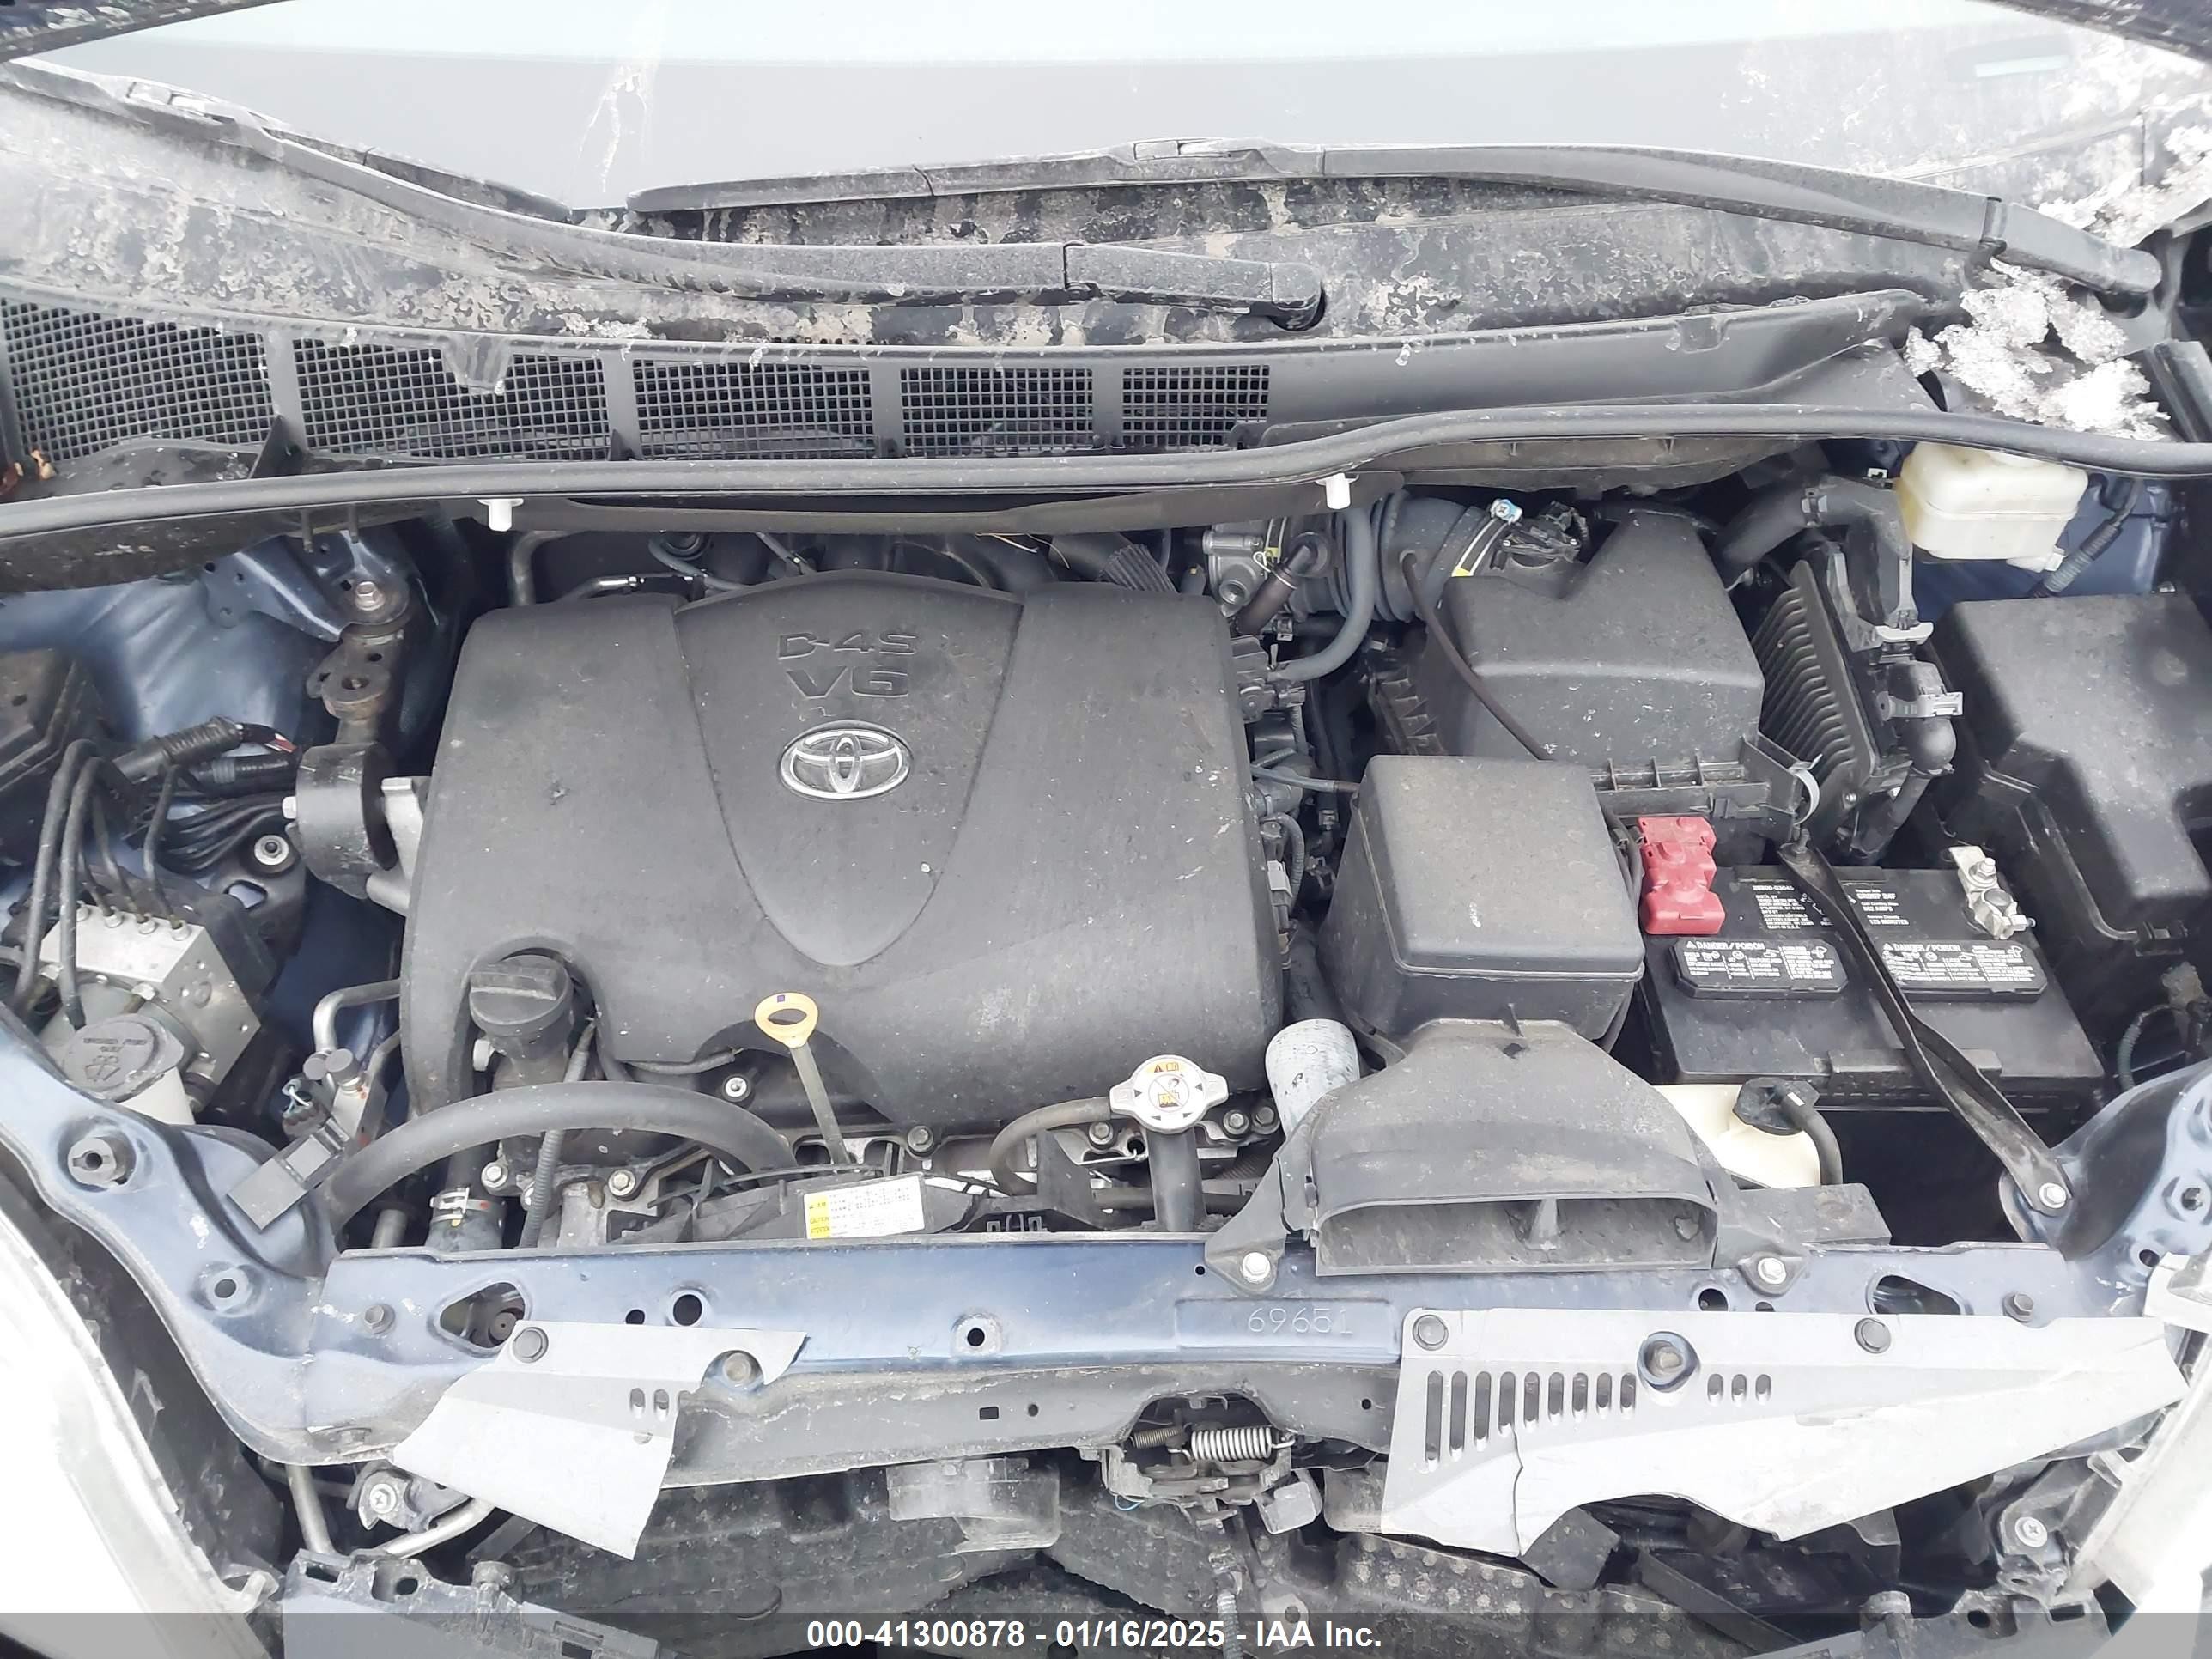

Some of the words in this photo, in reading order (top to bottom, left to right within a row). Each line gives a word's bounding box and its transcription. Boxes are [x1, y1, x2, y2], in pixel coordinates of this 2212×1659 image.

[777, 632, 917, 660] D-4S
[786, 665, 909, 699] V6
[1696, 941, 1729, 950] DANGER
[1735, 941, 1765, 950] POISON
[1932, 944, 1962, 952] POISON
[1248, 1307, 1353, 1334] 69651
